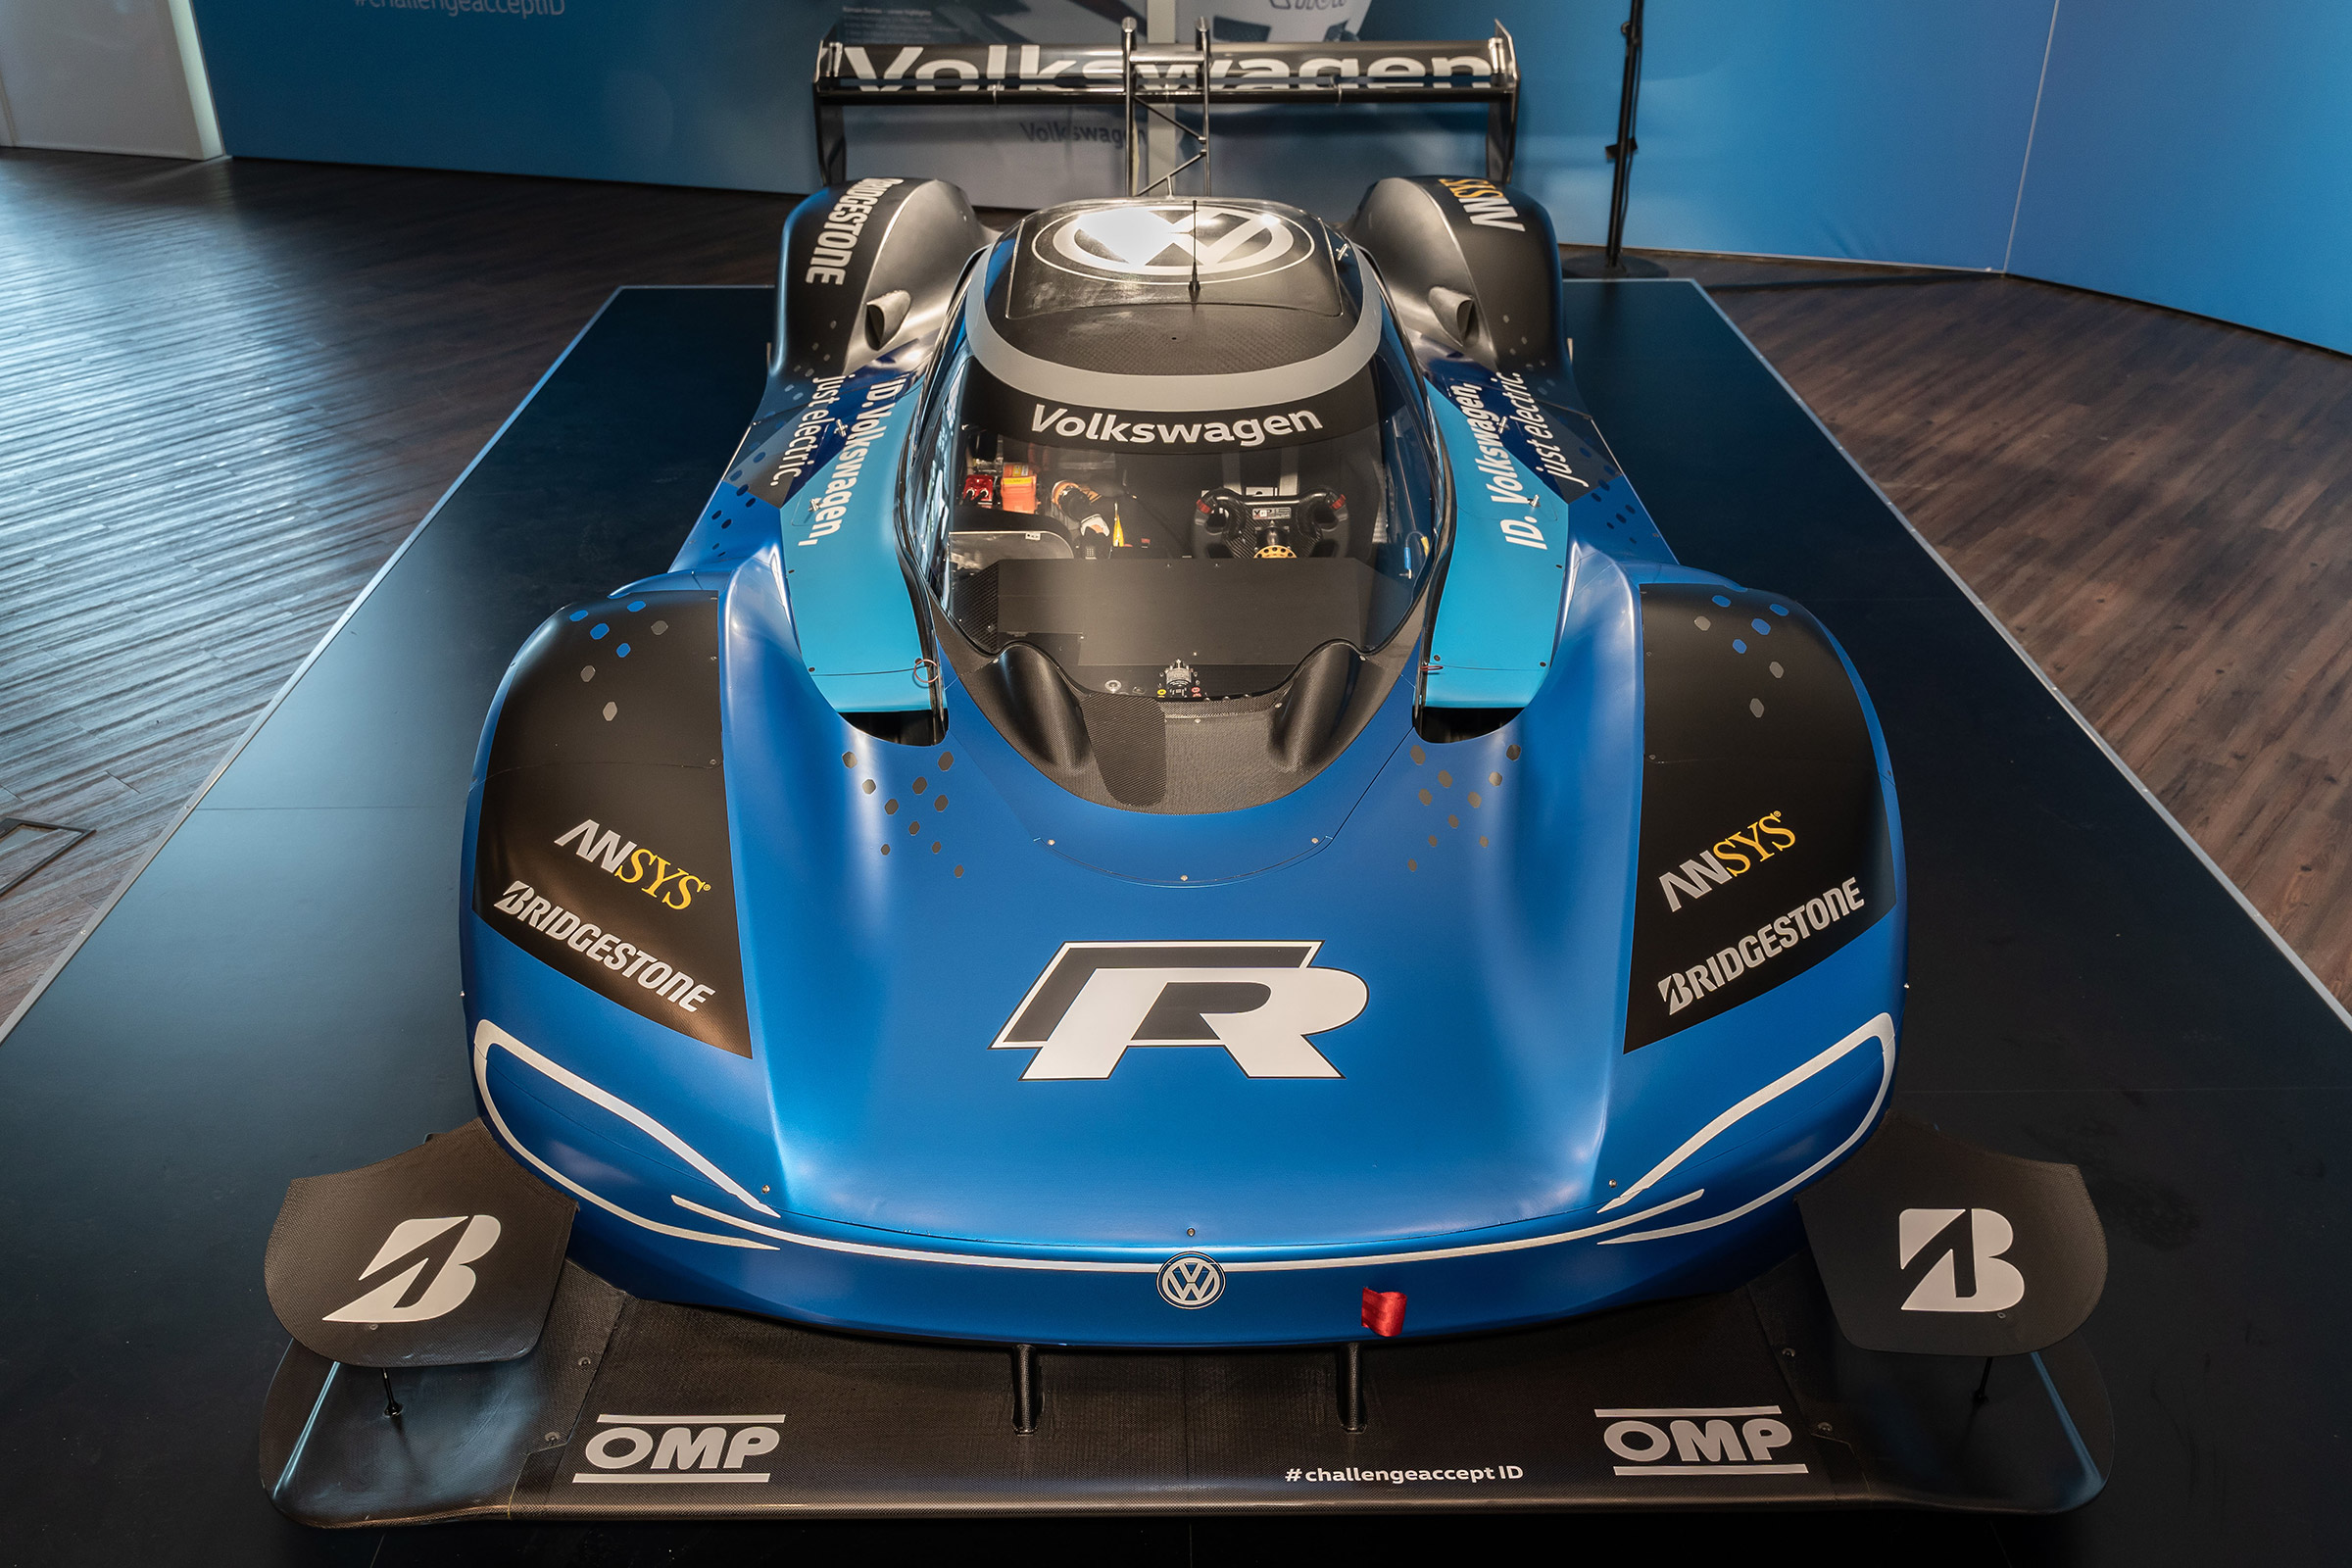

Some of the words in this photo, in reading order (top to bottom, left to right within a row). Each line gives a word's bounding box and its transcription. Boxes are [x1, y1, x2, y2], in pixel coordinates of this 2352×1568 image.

[1019, 122, 1146, 149] Volkswagn
[806, 373, 856, 408] just
[1490, 371, 1553, 440] electric.
[770, 410, 835, 486] electric.
[1032, 403, 1323, 447] Volkswagen
[1525, 438, 1590, 488] just
[493, 880, 715, 1012] BRIDGESTONE
[1657, 876, 1865, 1016] BRIDGESTONE
[585, 1427, 780, 1470] OMP
[1603, 1418, 1792, 1463] OMP
